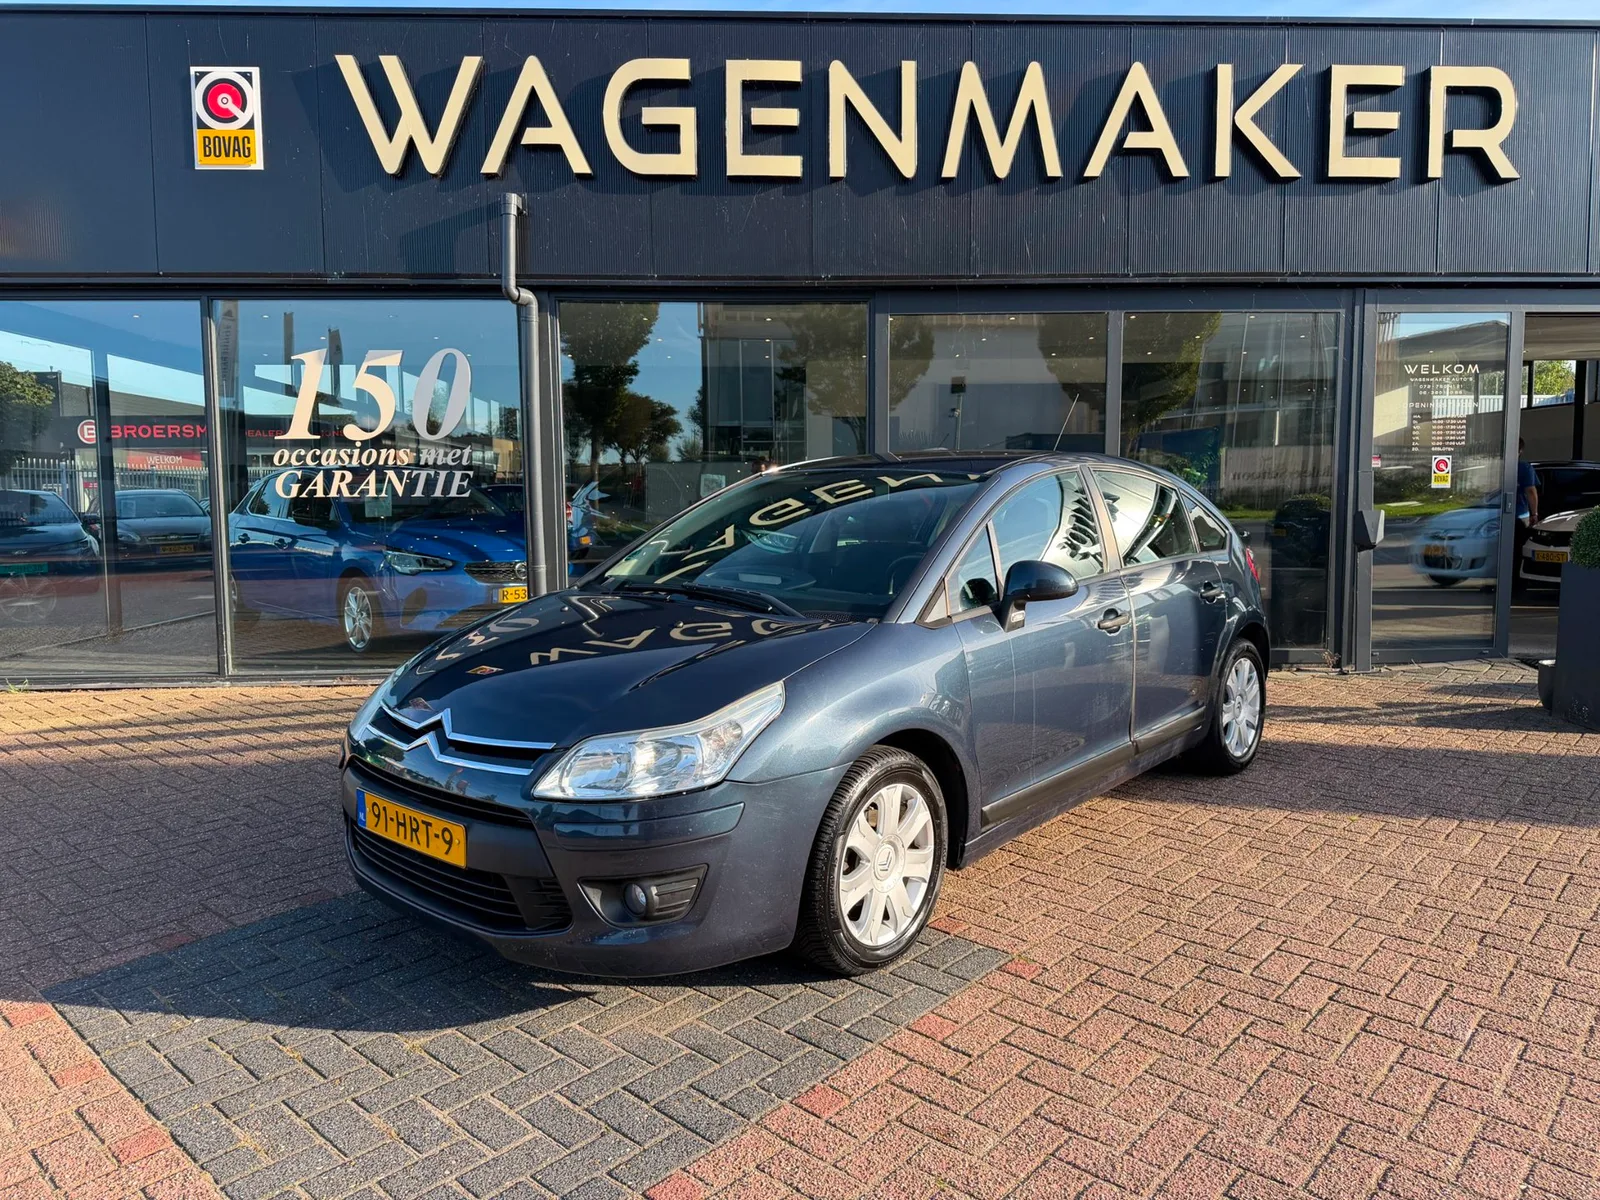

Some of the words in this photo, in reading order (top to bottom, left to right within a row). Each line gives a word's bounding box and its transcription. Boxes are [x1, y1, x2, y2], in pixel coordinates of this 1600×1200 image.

[335, 54, 1521, 180] WAGENMAKER
[202, 135, 251, 158] BOVAG
[1404, 364, 1480, 375] WELKOM
[274, 347, 472, 441] 150
[146, 456, 183, 464] WELKOM
[272, 441, 411, 466] occasions
[419, 445, 472, 467] met
[275, 469, 475, 499] GARANTIE
[502, 589, 527, 601] R-53
[371, 801, 454, 855] 91-HRT-9
